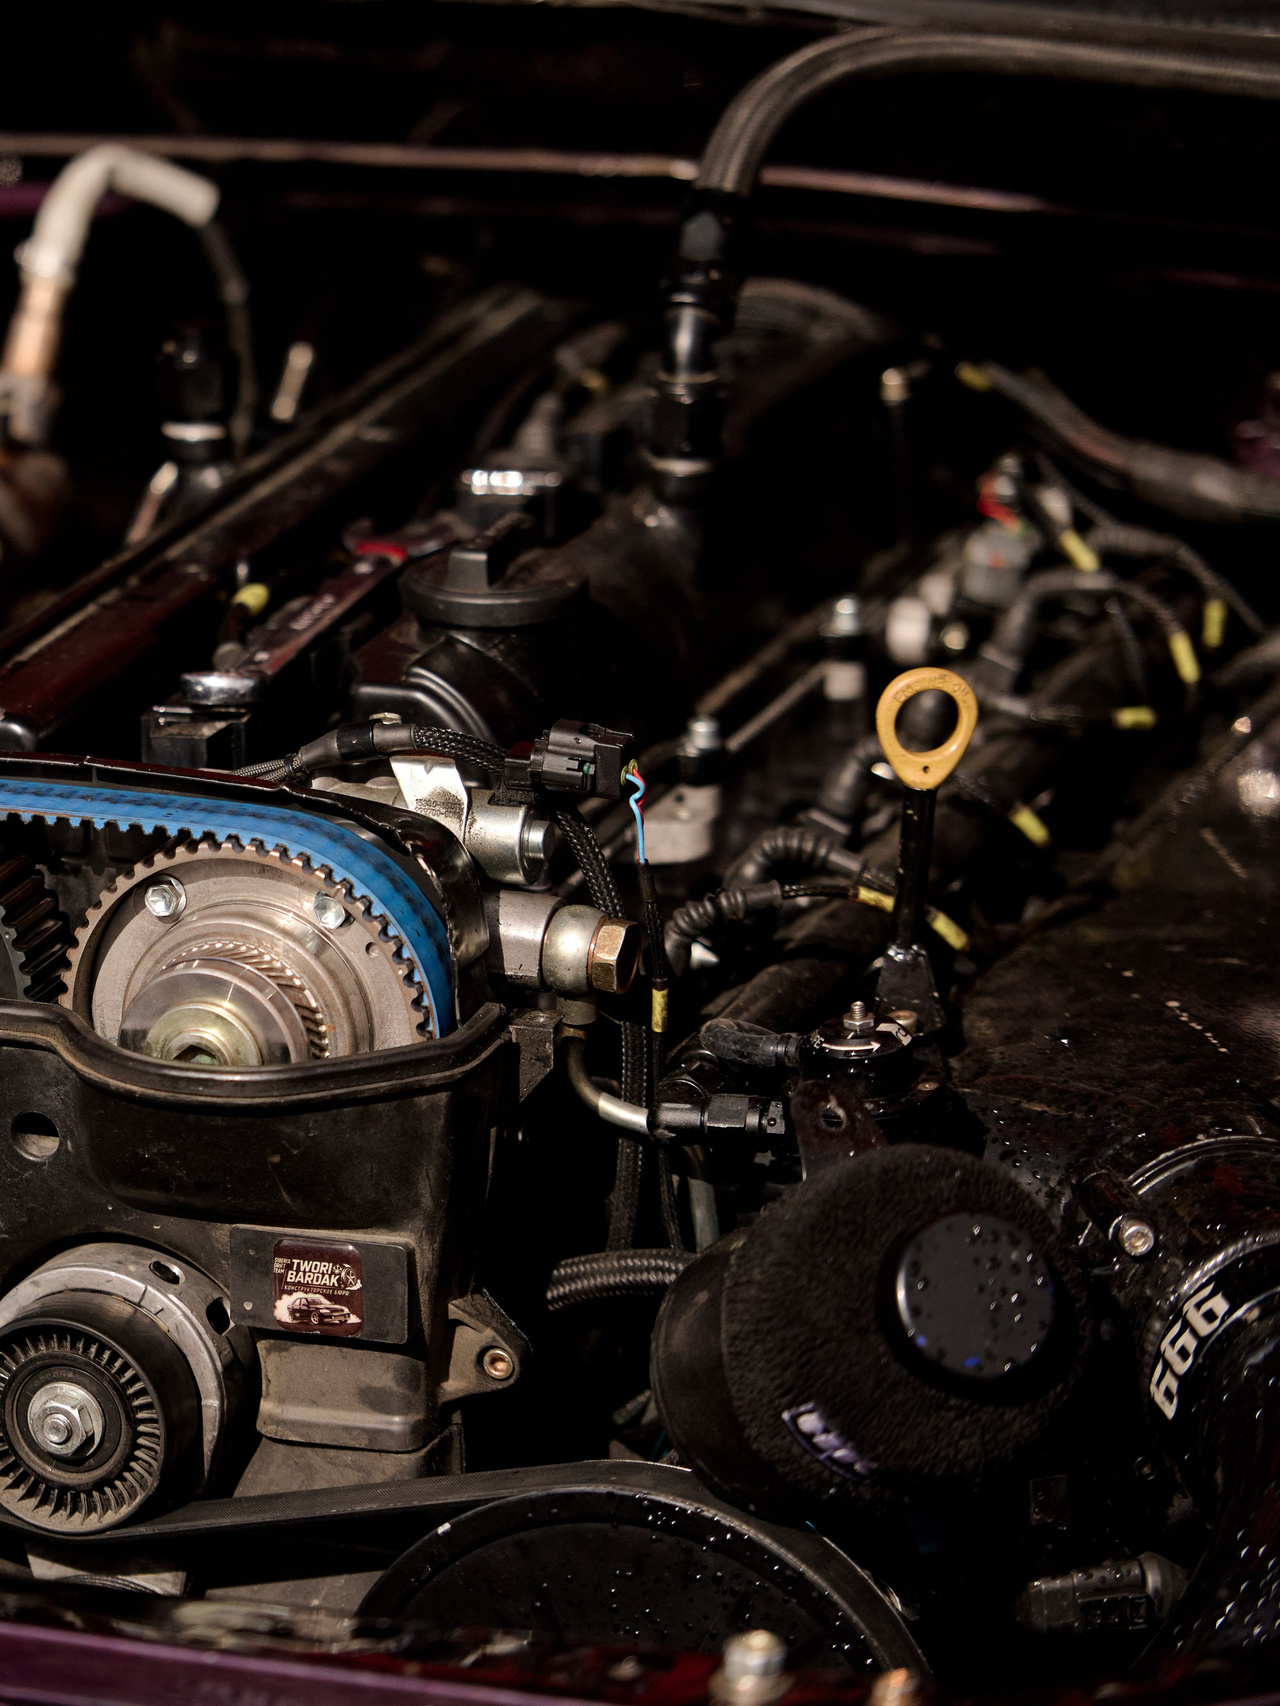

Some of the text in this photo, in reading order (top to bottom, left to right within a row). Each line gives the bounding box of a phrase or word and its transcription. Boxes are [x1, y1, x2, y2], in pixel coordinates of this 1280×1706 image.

[292, 1259, 333, 1274] TWORI
[286, 1270, 340, 1287] BARDAK
[284, 1285, 333, 1295] КОНСТРУКТОРСКОЕ
[1149, 1281, 1231, 1421] 666
